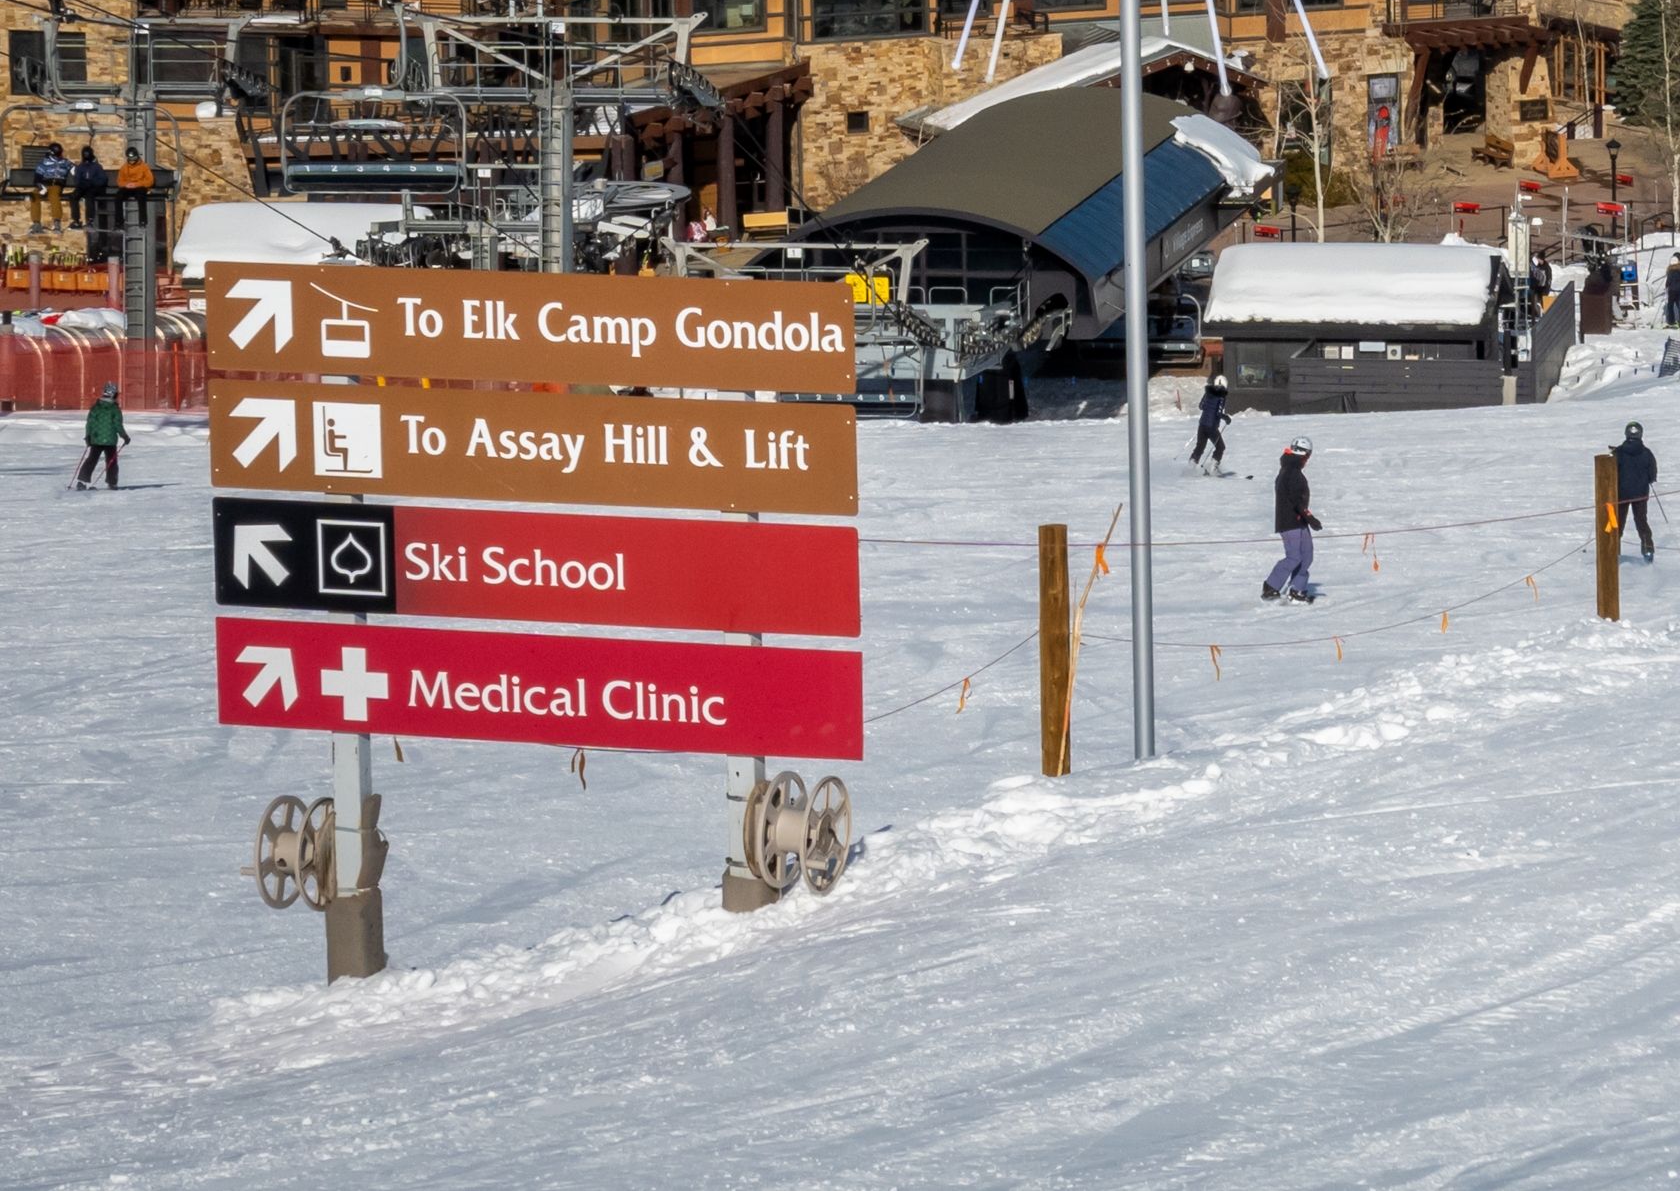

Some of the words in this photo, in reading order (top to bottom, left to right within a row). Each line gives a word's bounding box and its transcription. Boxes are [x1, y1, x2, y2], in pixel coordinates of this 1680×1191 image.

[396, 297, 444, 338] To
[462, 300, 520, 341] Elk
[537, 302, 657, 358] Camp
[675, 306, 846, 353] Gondola
[400, 414, 447, 456] To
[465, 418, 585, 474] Assay
[603, 423, 669, 465] Hill
[688, 426, 724, 467] &
[744, 429, 810, 471] Lift
[405, 542, 468, 582] Ski
[482, 546, 625, 590] School
[408, 669, 587, 717] Medical
[602, 680, 727, 726] Clinic
